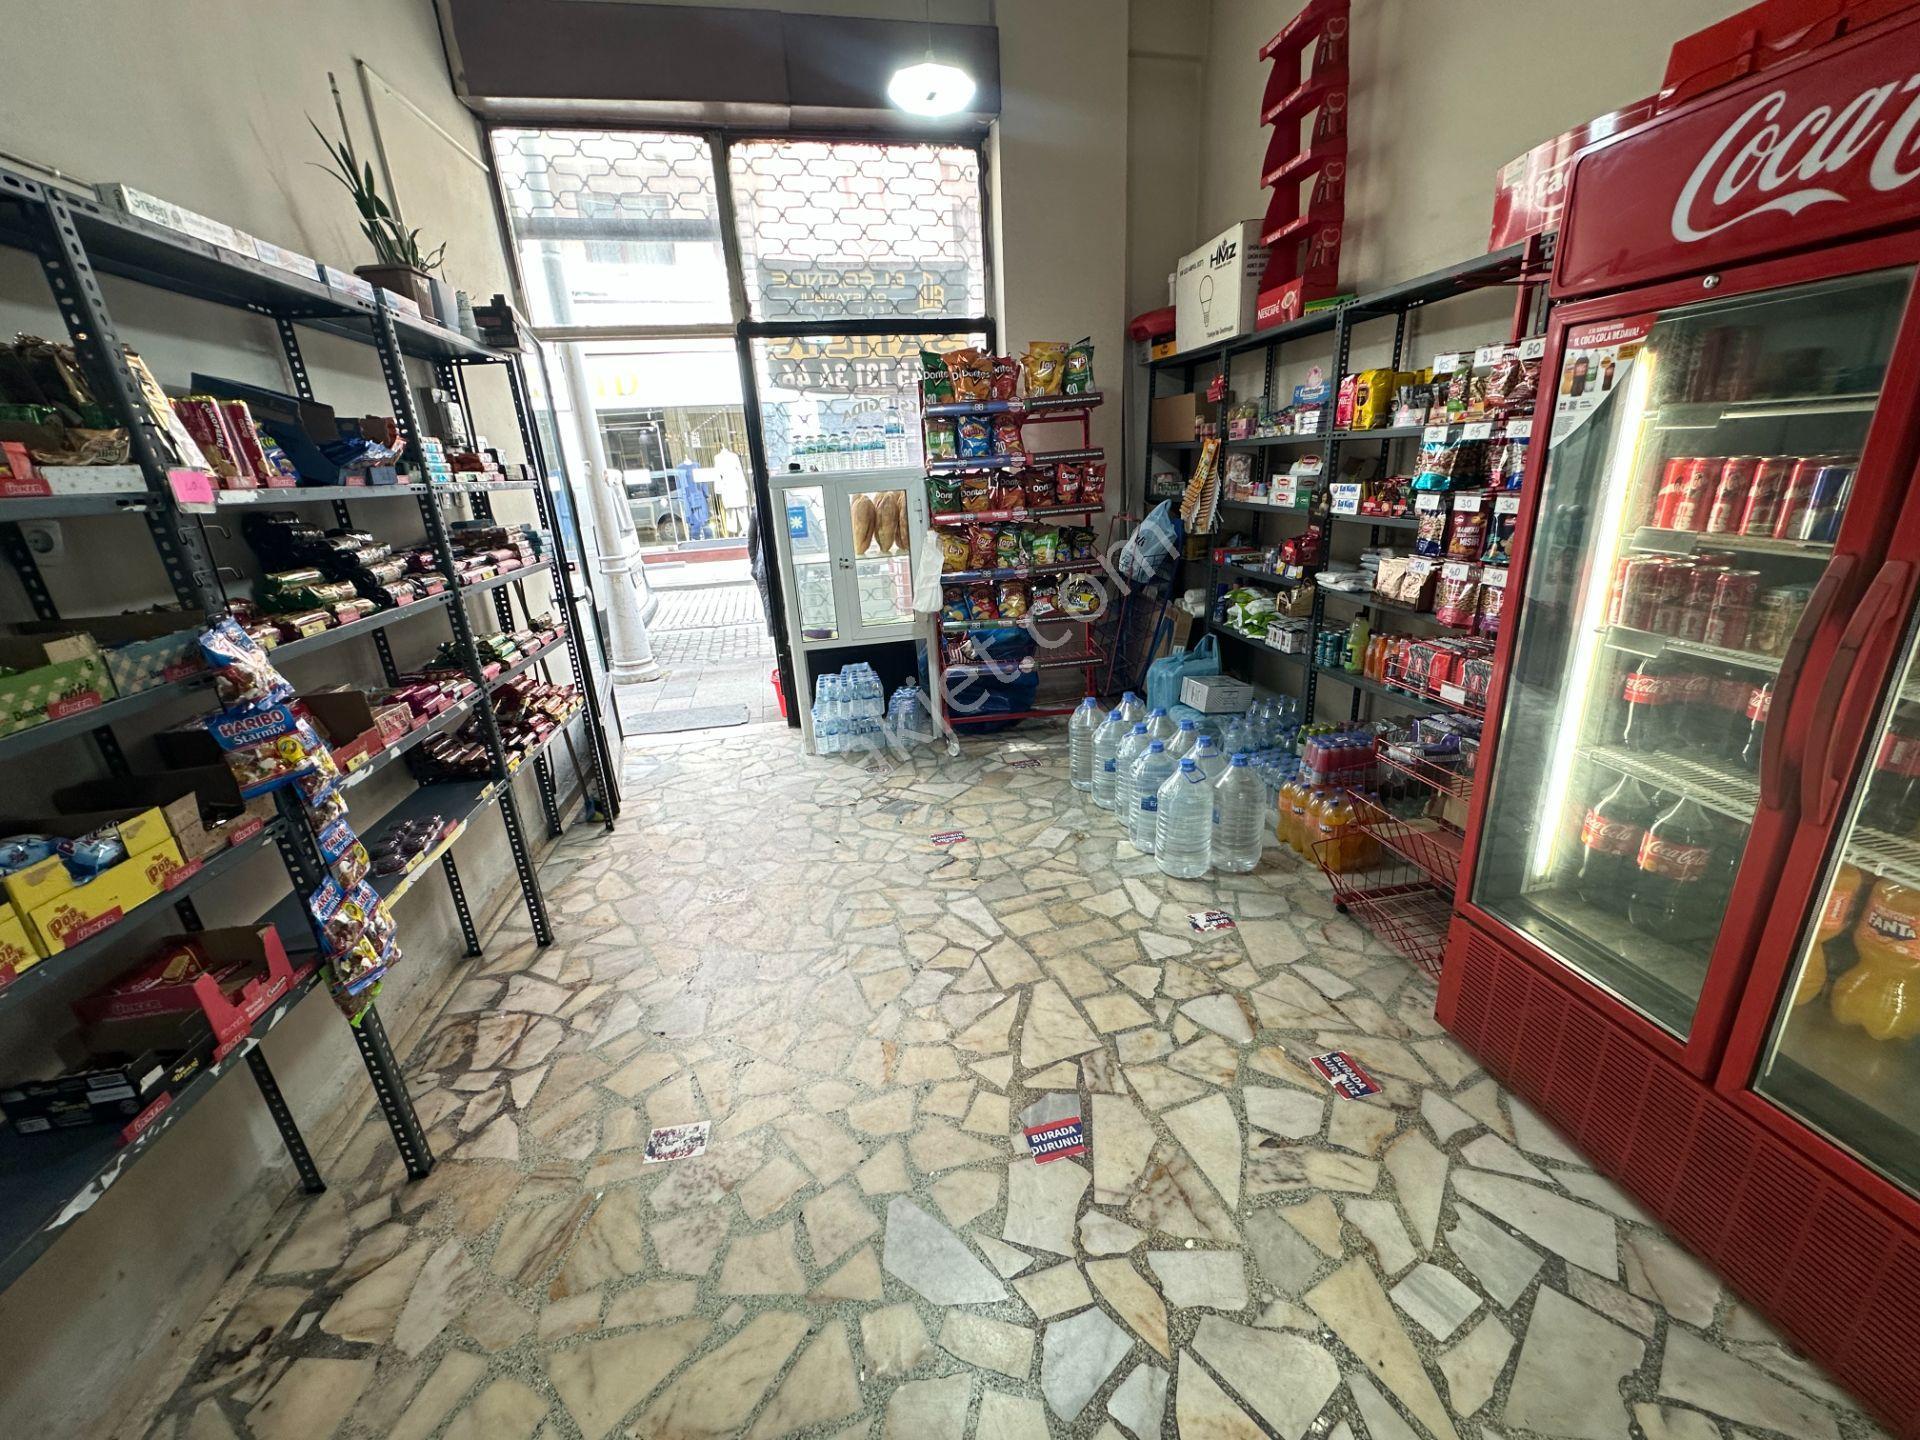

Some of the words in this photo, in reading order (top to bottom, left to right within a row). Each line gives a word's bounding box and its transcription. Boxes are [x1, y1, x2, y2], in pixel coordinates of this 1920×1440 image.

[1210, 241, 1237, 268] HMZ
[1462, 499, 1472, 508] 30
[218, 709, 285, 738] HARIBO
[233, 725, 285, 745] Starmix
[1868, 911, 1918, 939] FANTA
[1332, 1056, 1367, 1090] BURADA
[1030, 1134, 1084, 1156] DURUNUZ
[1031, 1125, 1077, 1144] BURADA
